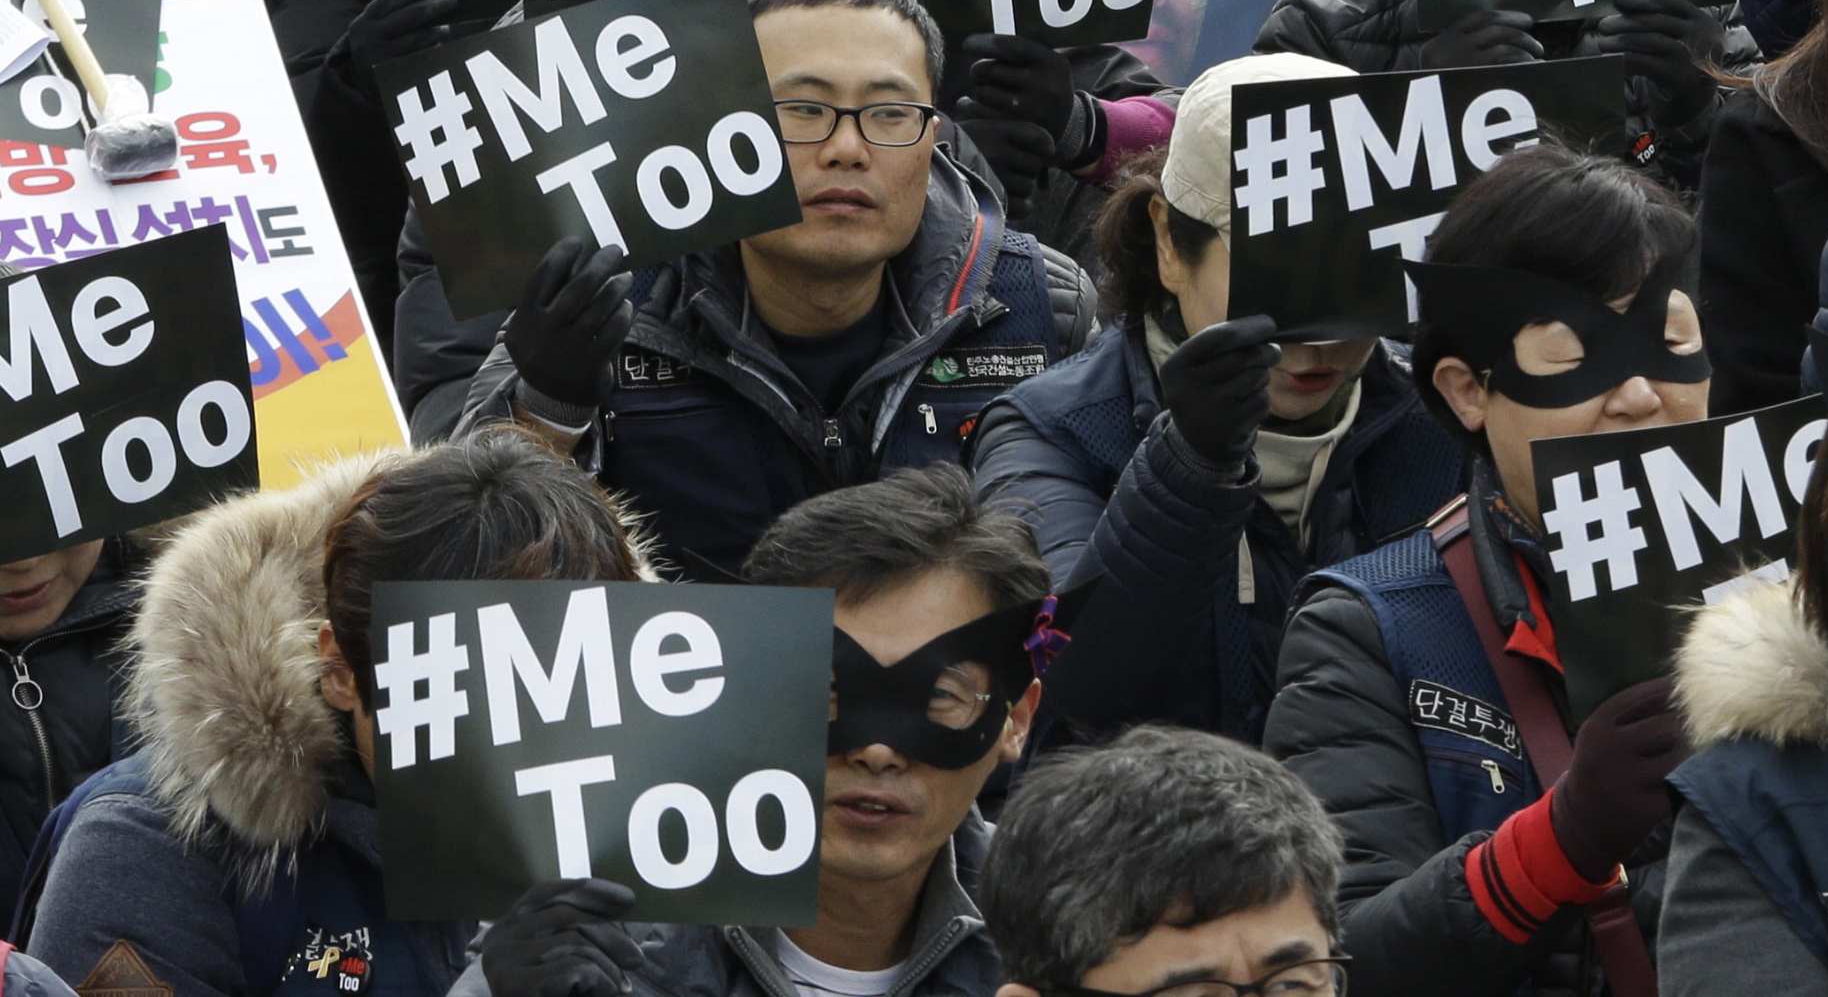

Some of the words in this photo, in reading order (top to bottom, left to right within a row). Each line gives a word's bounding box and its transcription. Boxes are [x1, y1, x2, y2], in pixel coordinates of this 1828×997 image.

[395, 15, 677, 204] #Me
[1234, 75, 1540, 237] #Me
[1637, 145, 1656, 164] Too
[535, 111, 783, 257] Too
[0, 272, 155, 402] Me
[625, 355, 694, 381] 단결
[0, 380, 252, 539] Too
[374, 586, 726, 770] #Me
[1415, 688, 1517, 750] 단결투쟁
[514, 754, 816, 890] Too
[338, 973, 360, 992] Too
